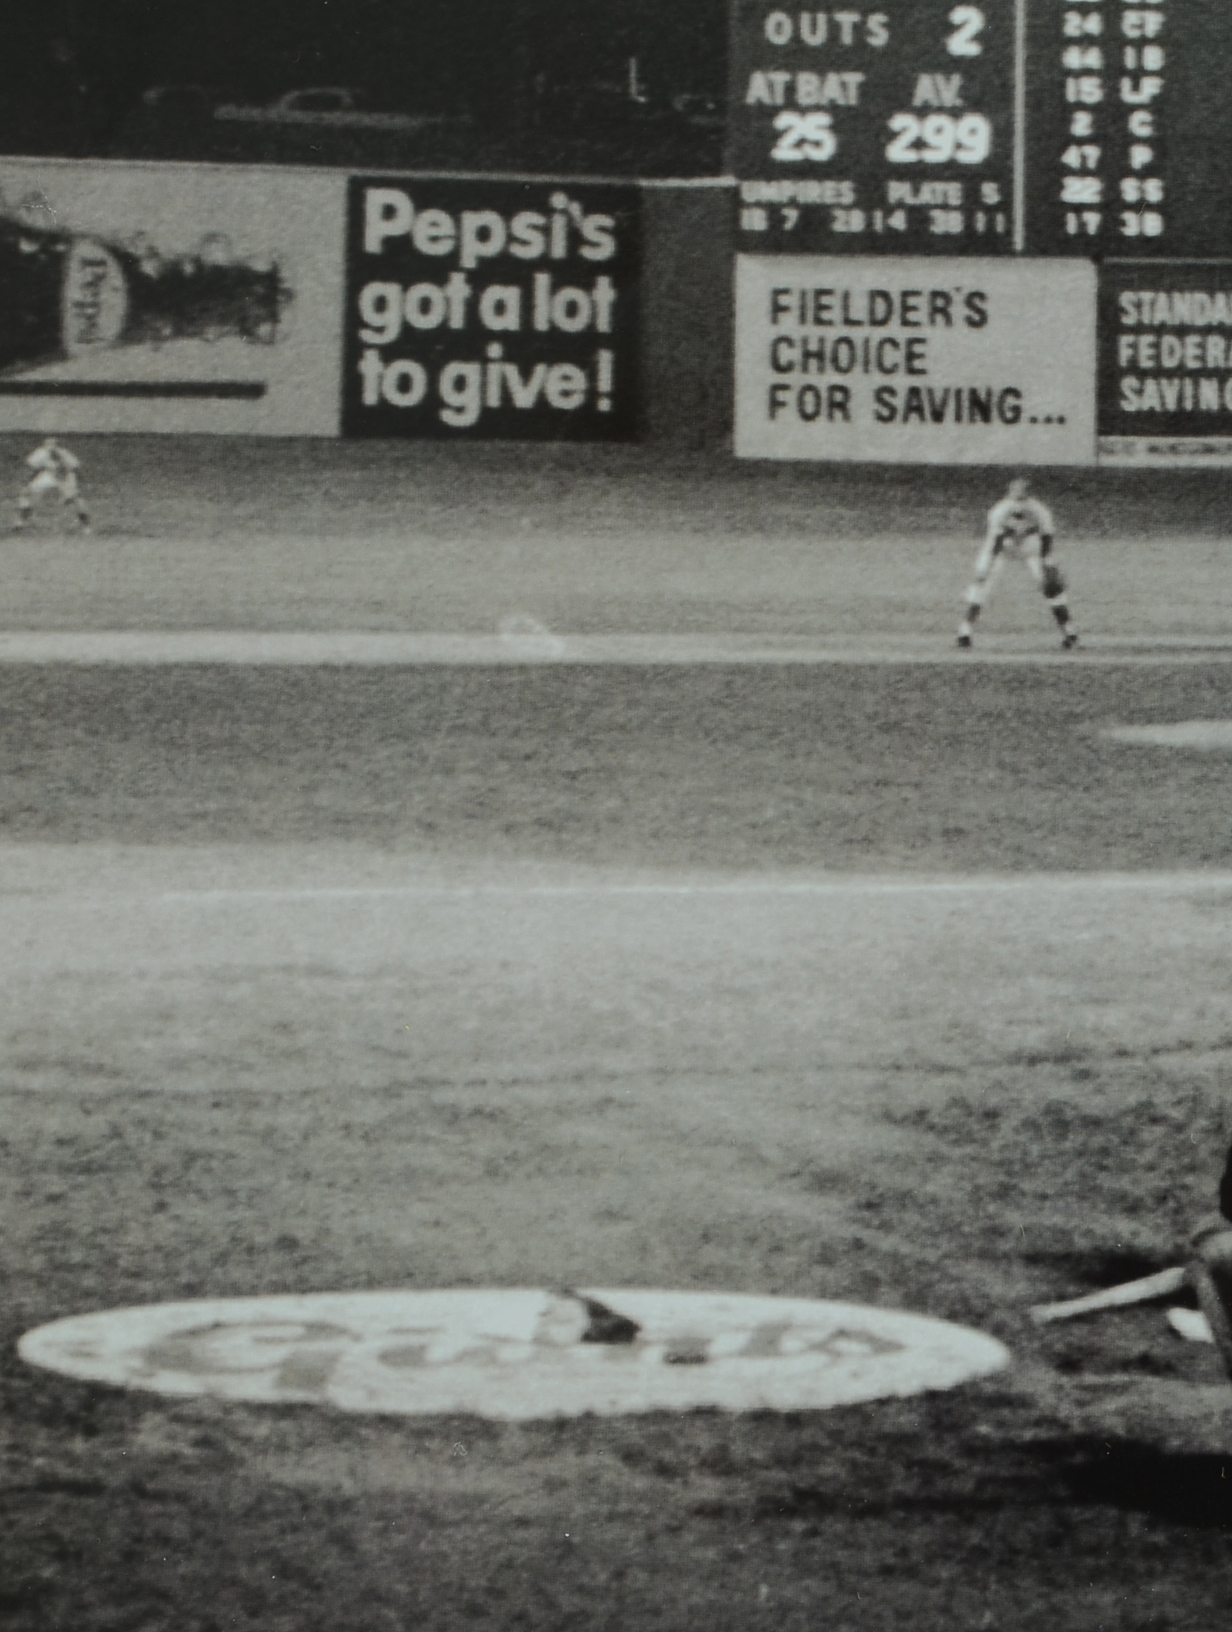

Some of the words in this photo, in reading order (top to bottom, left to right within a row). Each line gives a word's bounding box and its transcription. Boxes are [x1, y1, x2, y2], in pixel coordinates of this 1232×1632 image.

[765, 11, 889, 47] OUTS
[946, 6, 984, 56] 2
[1064, 12, 1102, 36] 24
[746, 71, 792, 105] AT
[796, 72, 865, 106] BAT
[1066, 76, 1103, 104] 15
[1120, 76, 1163, 104] LF
[771, 111, 836, 161] 25
[886, 113, 991, 164] 299
[1071, 111, 1092, 136] 2
[1129, 110, 1153, 137] C
[1061, 145, 1101, 169] 47
[1130, 144, 1153, 169] P
[888, 181, 961, 206] PLATE
[363, 187, 617, 269] Pepsi's
[781, 207, 799, 230] 7
[1067, 212, 1101, 234] 17
[359, 272, 471, 344] got
[479, 285, 521, 331] a
[533, 272, 616, 332] lot
[771, 288, 988, 329] FIELDER'S
[770, 336, 927, 376] CHOICE
[358, 349, 427, 407] to
[769, 383, 851, 422] FOR
